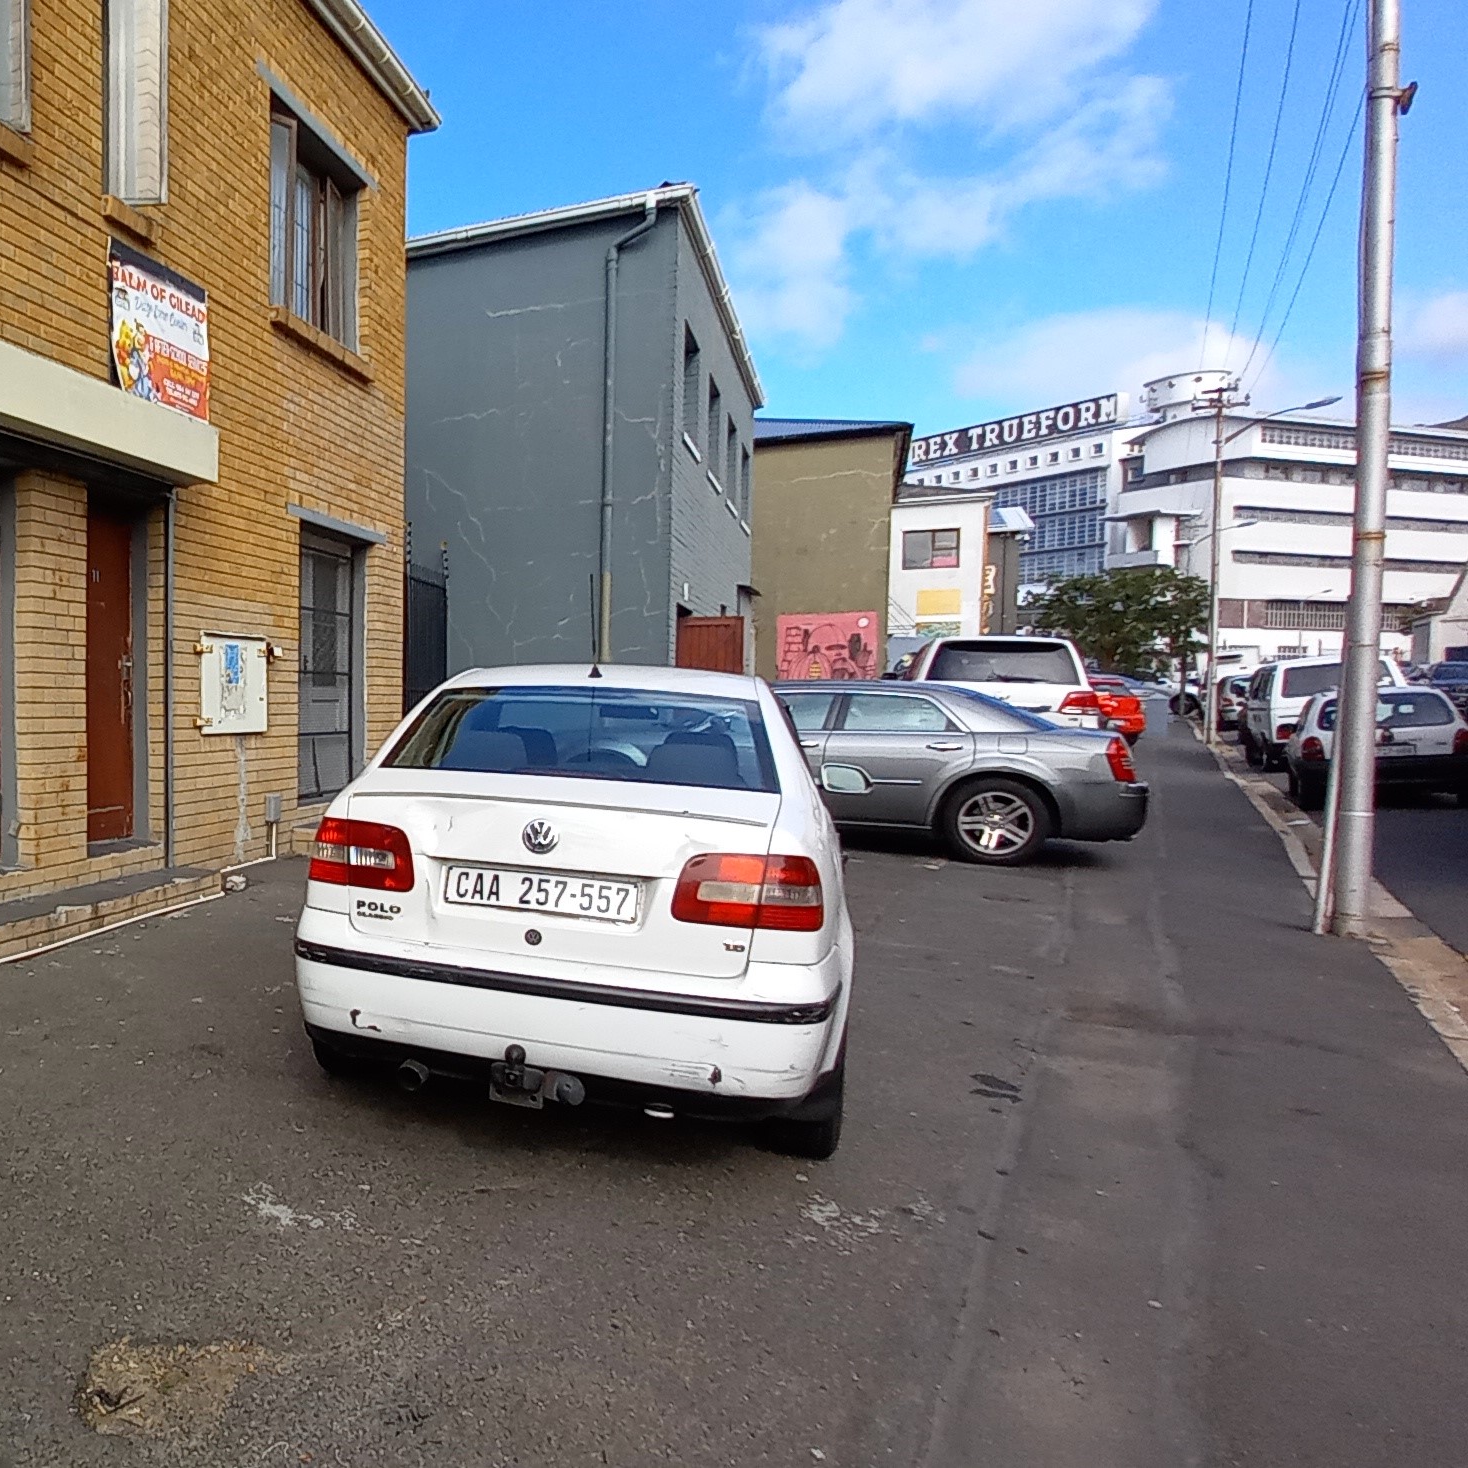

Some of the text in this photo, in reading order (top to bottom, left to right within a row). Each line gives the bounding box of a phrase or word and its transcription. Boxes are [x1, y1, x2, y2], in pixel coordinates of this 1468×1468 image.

[150, 283, 167, 304] OF
[168, 292, 207, 324] GILEAD
[913, 396, 1117, 462] REX TRUEFORM
[356, 899, 401, 914] POLO
[456, 871, 630, 916] CAA 257-557
